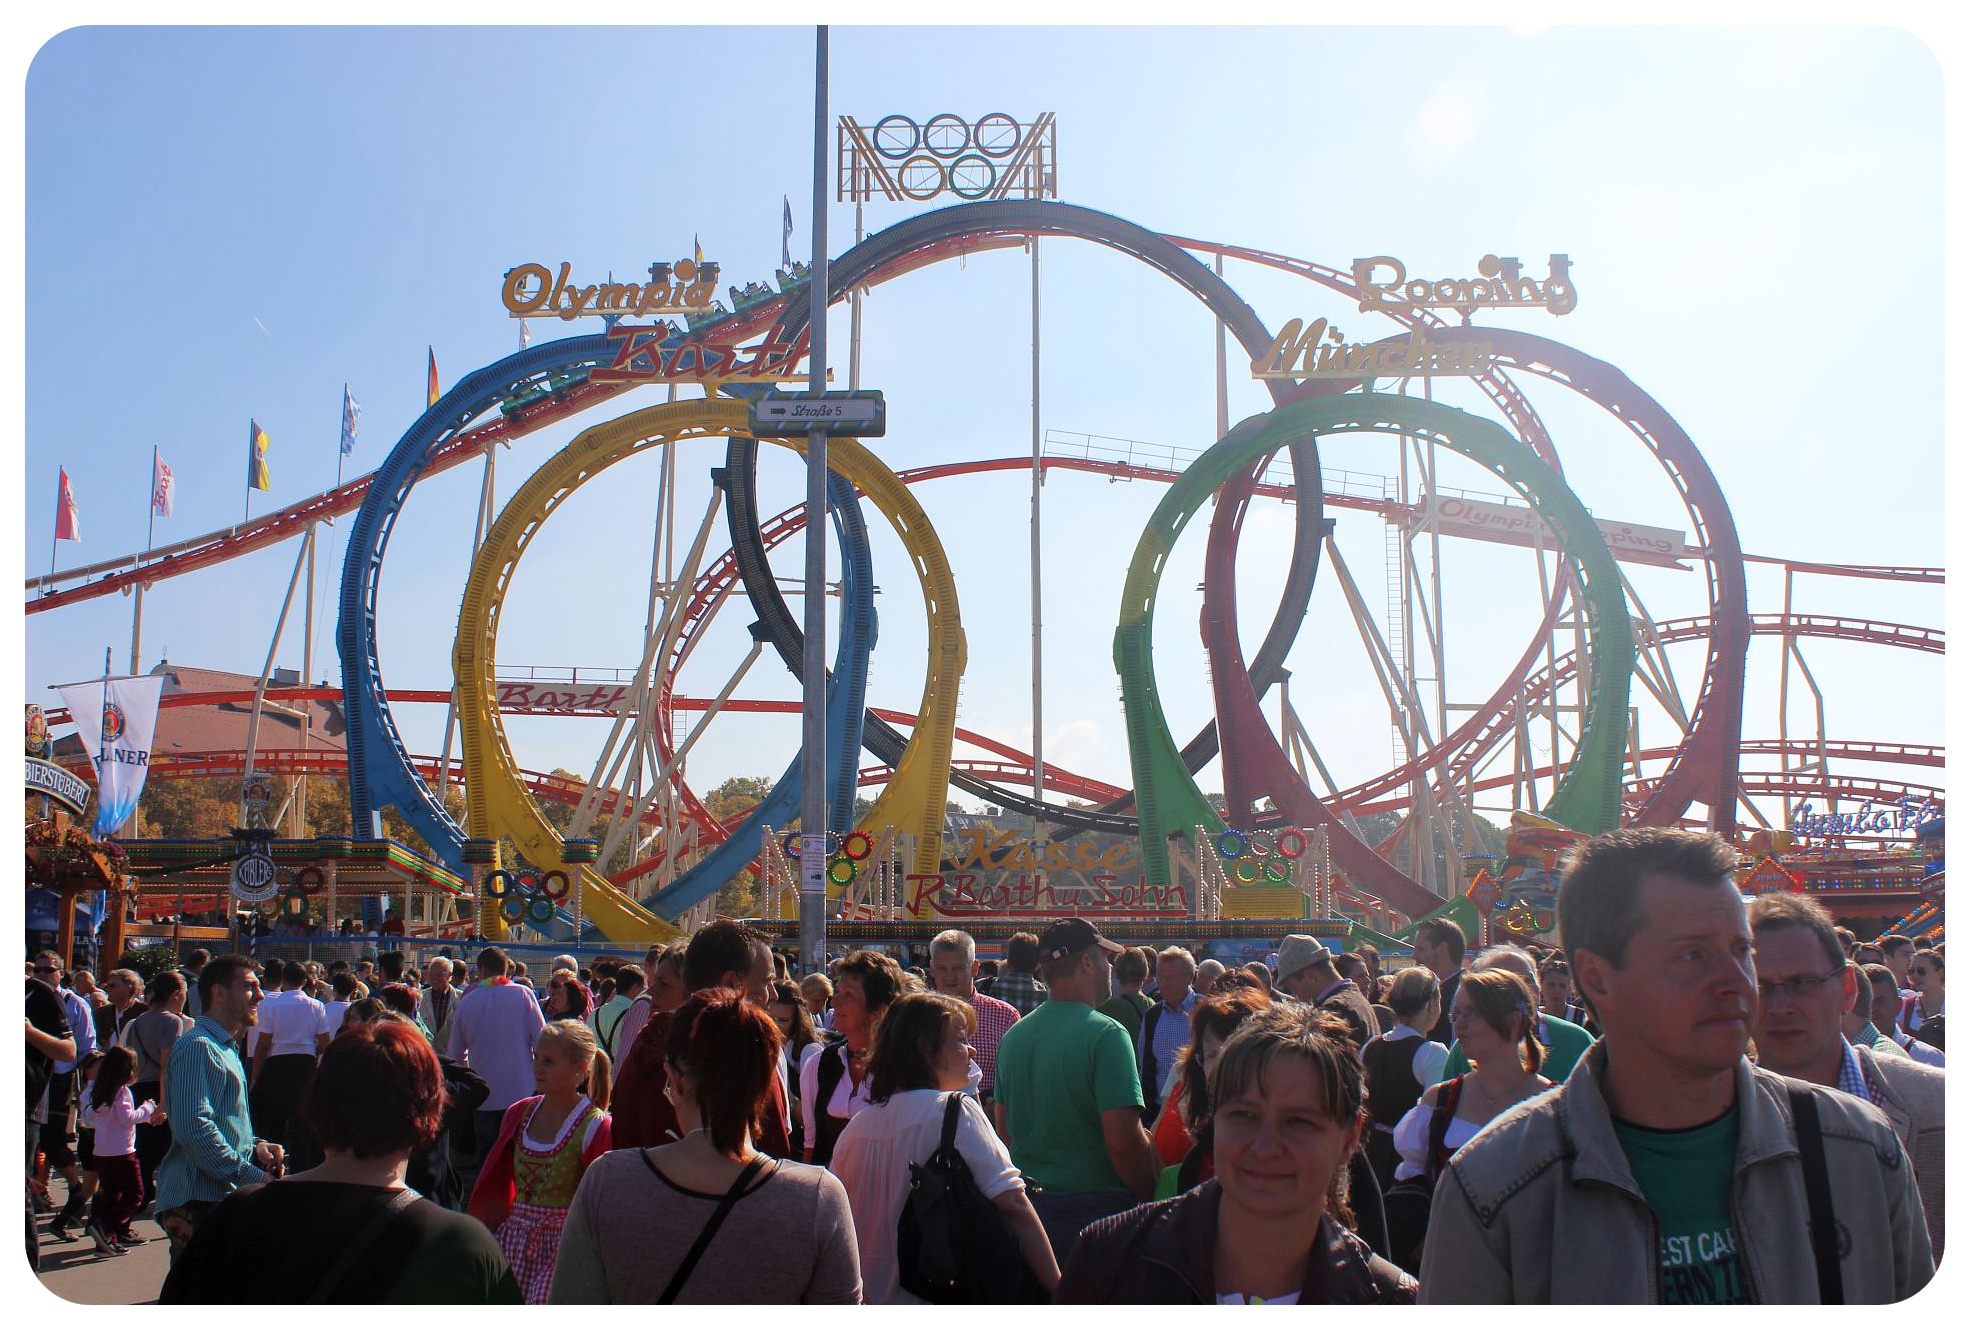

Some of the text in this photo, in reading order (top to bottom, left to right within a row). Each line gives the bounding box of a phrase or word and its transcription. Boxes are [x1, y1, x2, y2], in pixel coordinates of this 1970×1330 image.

[502, 258, 717, 321] Olympia
[1352, 254, 1577, 315] Looping
[1250, 317, 1493, 372] München
[791, 404, 842, 417] Straße 5
[951, 828, 1137, 872] Kasse
[1092, 873, 1189, 907] Sohn
